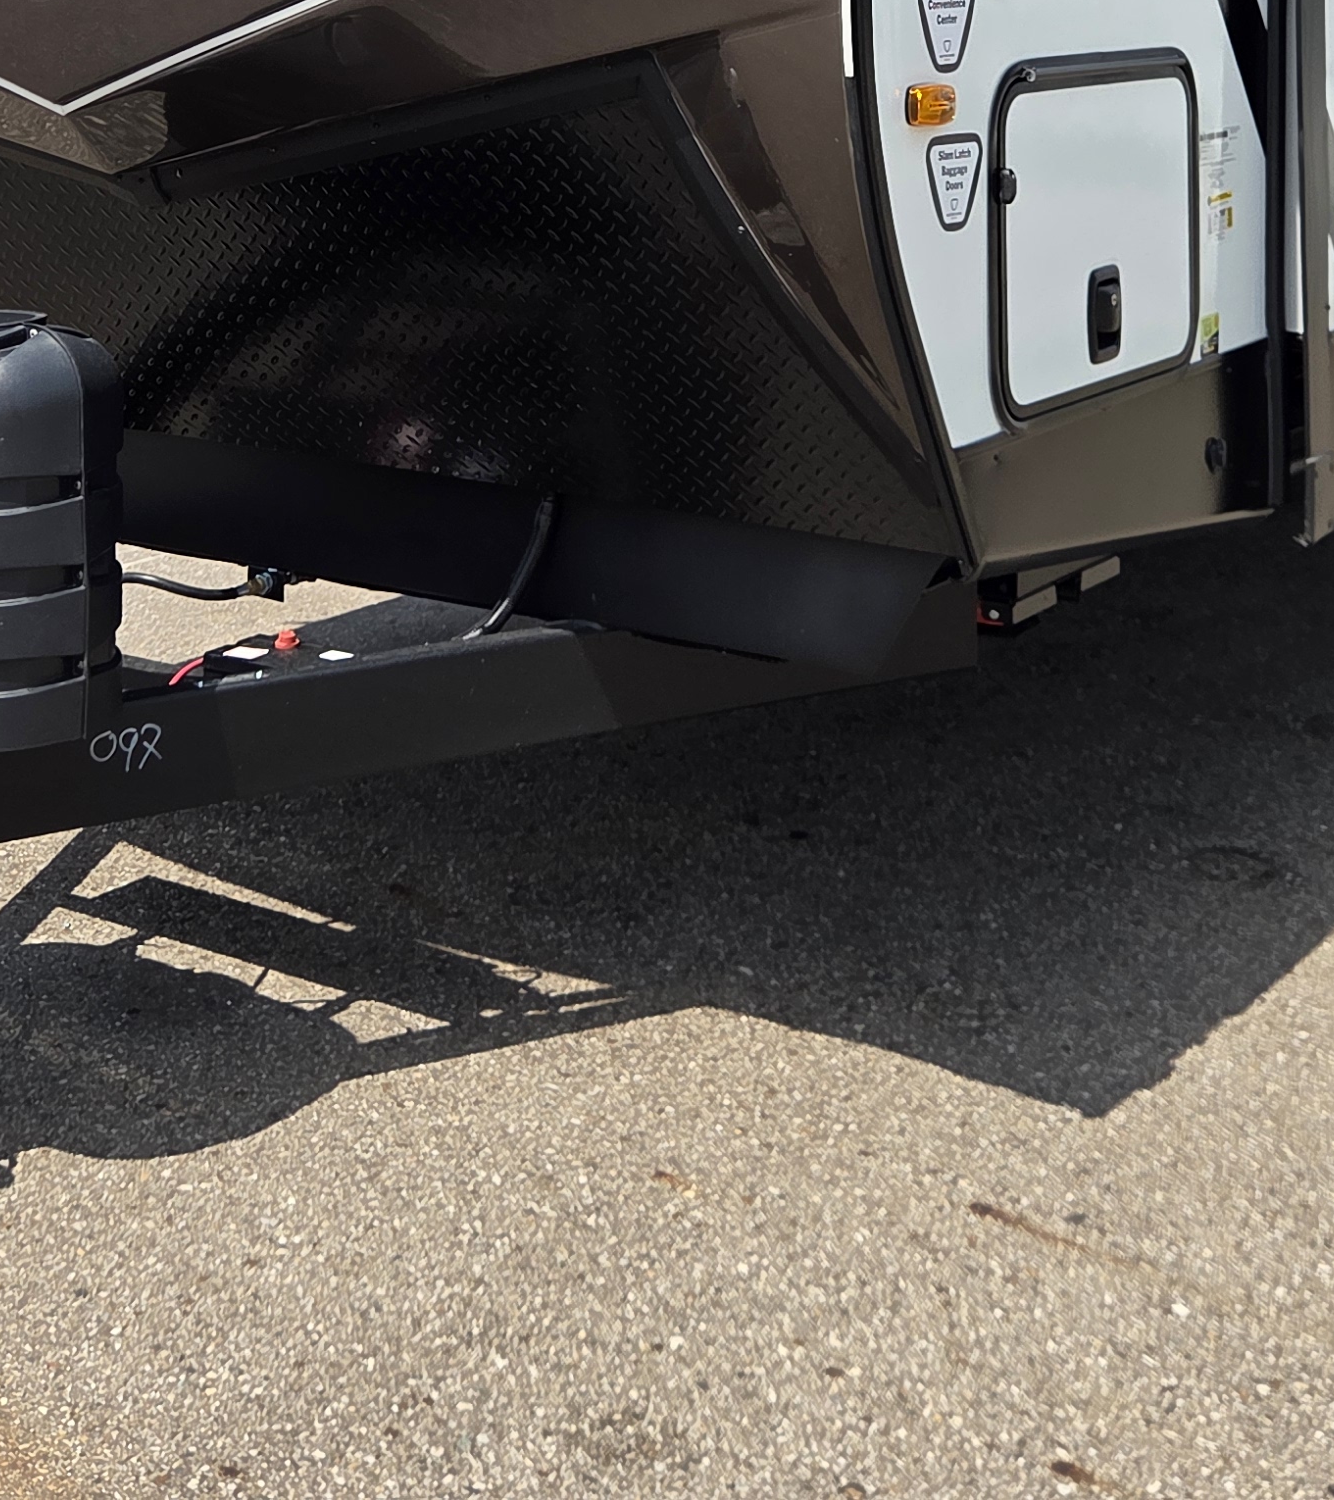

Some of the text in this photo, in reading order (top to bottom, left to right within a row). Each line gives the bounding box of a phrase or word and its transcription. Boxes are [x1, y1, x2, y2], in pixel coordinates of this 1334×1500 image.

[936, 14, 958, 25] Center
[954, 147, 971, 160] Latch
[941, 165, 967, 178] Baggage
[945, 180, 963, 191] Doors
[89, 723, 162, 772] 097
